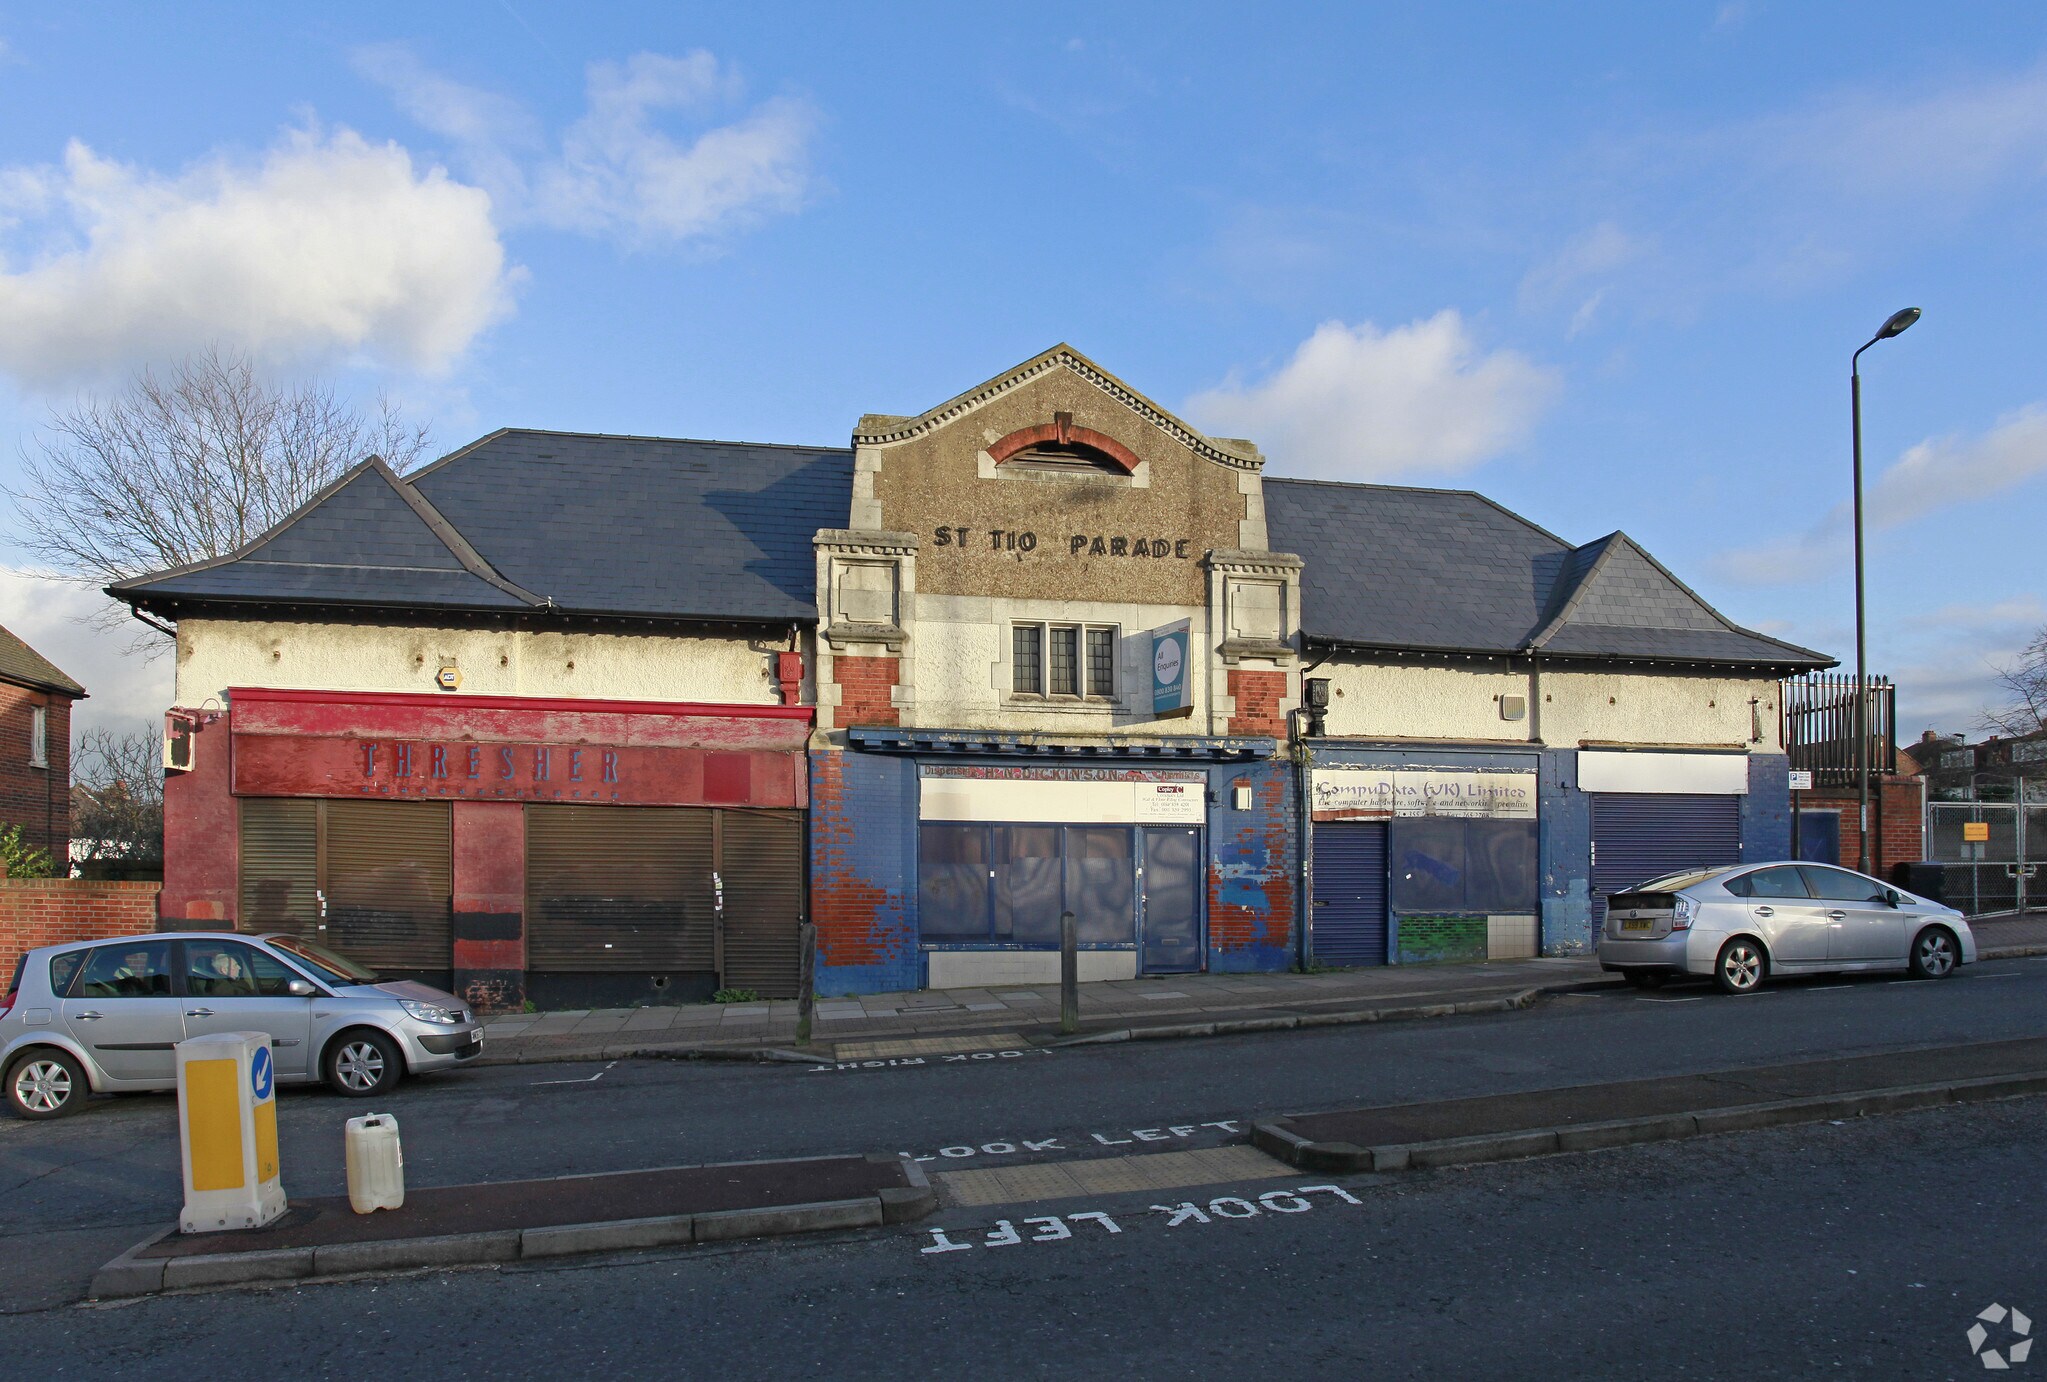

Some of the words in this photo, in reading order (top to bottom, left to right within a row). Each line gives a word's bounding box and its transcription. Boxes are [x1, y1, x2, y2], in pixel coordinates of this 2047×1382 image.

[1070, 534, 1190, 559] PARADE
[1157, 660, 1178, 671] Enquiries
[360, 743, 618, 783] THRESHER
[1423, 781, 1460, 797] (UK)
[1467, 783, 1526, 798] Limited
[1407, 798, 1436, 807] softwe
[1495, 800, 1529, 808] pecalists
[808, 1057, 926, 1072] RIGHT
[941, 1048, 1053, 1063] LOOK
[898, 1138, 1066, 1162] LOOK
[1091, 1120, 1240, 1146] LEFT
[1149, 1184, 1363, 1228] LOOK
[920, 1211, 1122, 1254] LEFT
